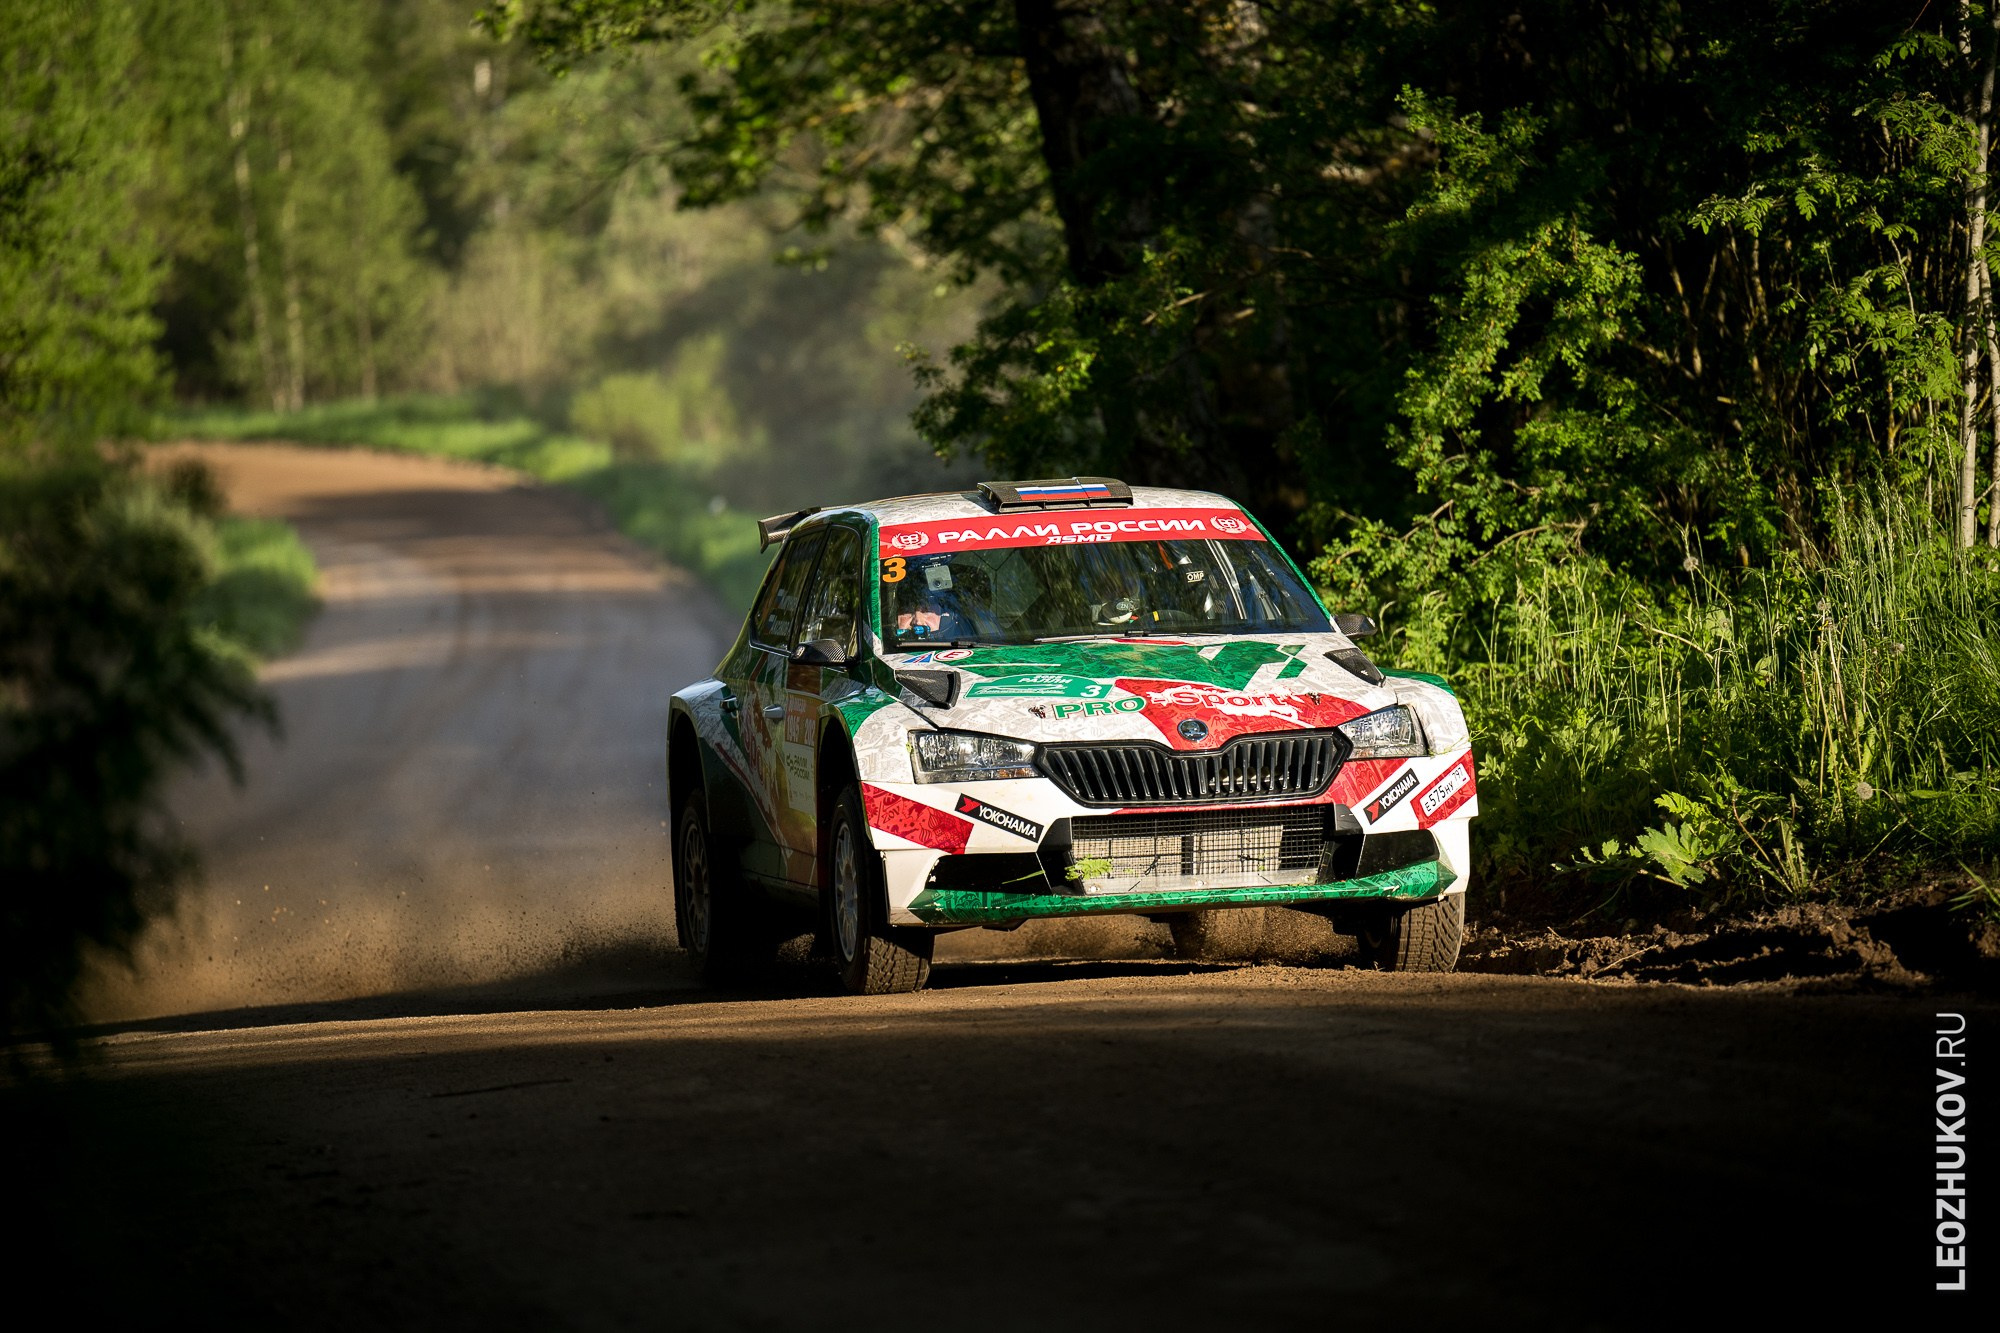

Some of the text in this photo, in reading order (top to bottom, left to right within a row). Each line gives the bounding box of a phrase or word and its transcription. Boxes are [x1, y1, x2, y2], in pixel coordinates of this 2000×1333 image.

[937, 519, 1206, 545] РАЛЛИ РОССИИ
[882, 557, 907, 583] 3
[1186, 571, 1204, 582] OMP
[1080, 685, 1102, 697] 3
[1379, 773, 1417, 810] YOKOHAMA
[979, 805, 1037, 839] YOKOHAMA
